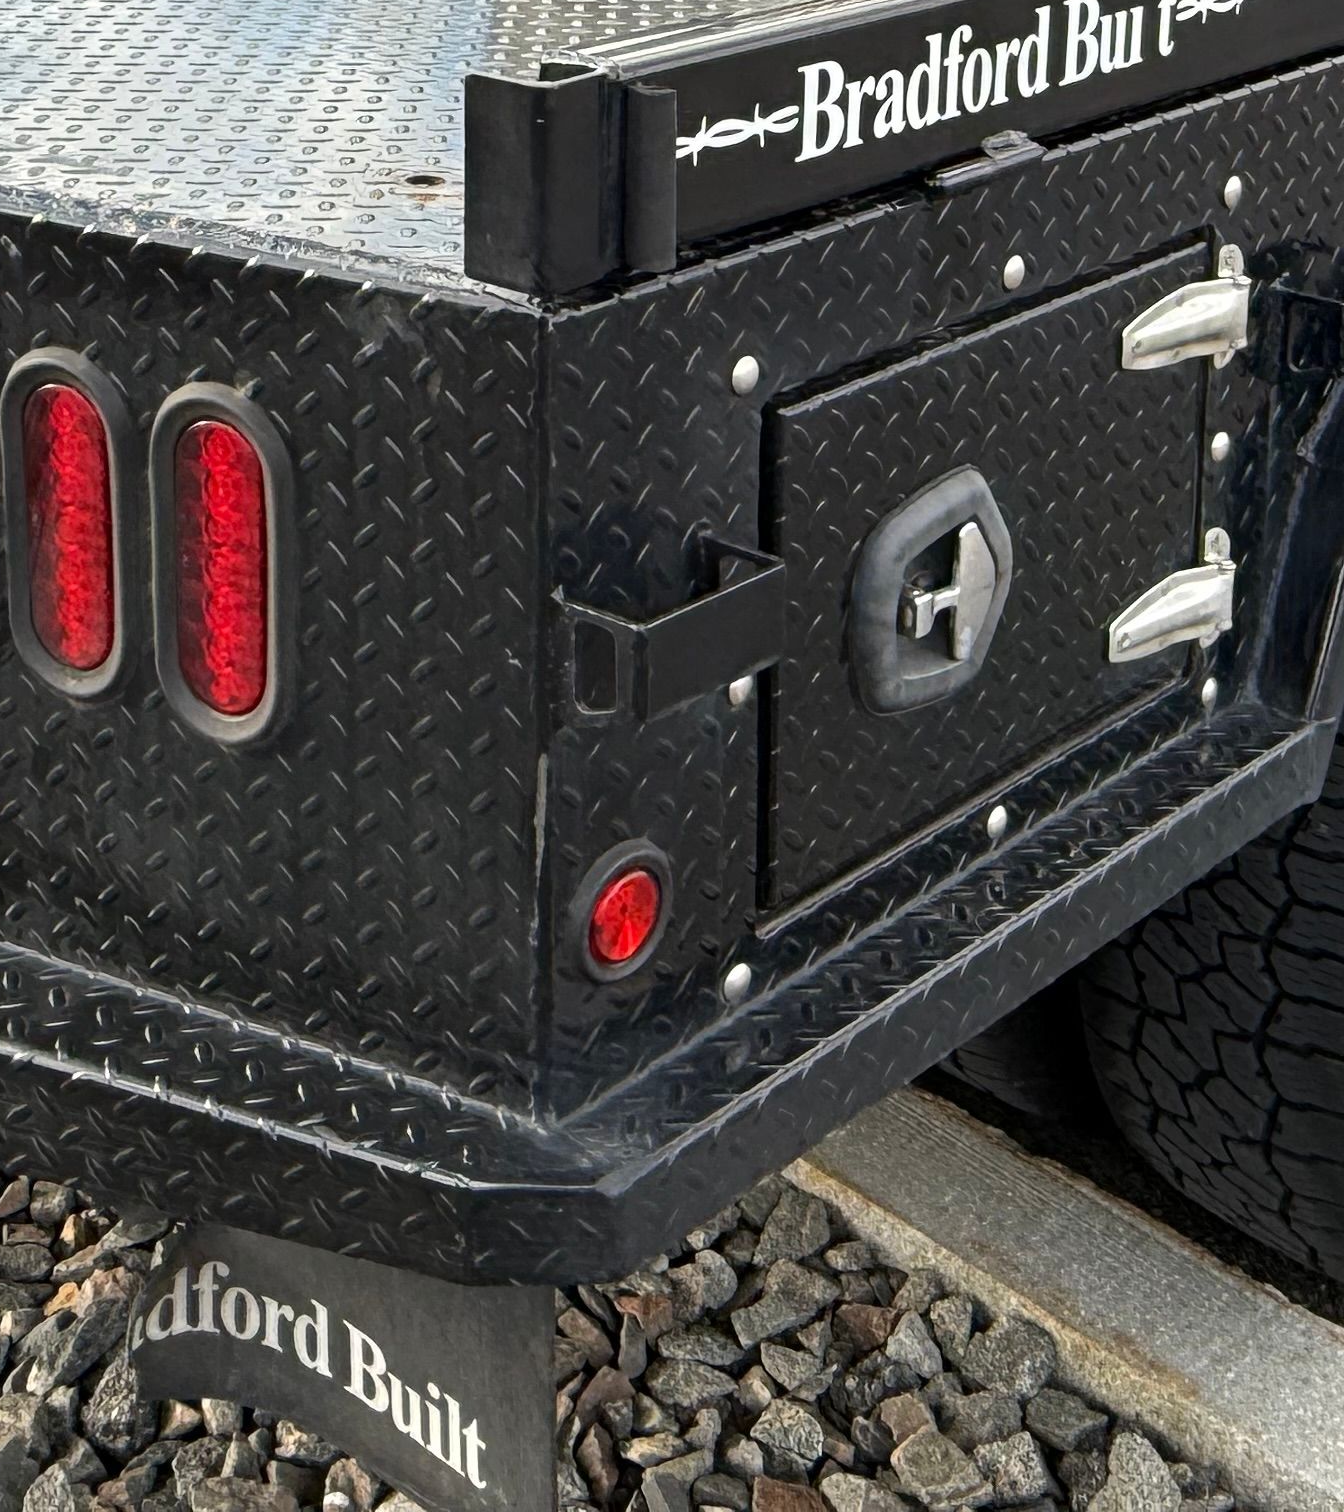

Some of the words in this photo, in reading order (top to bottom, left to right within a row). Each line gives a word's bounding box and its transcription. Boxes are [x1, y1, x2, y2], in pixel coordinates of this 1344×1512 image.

[793, 4, 1051, 163] Bradford
[131, 1260, 333, 1379] dford
[342, 1318, 488, 1489] Built
